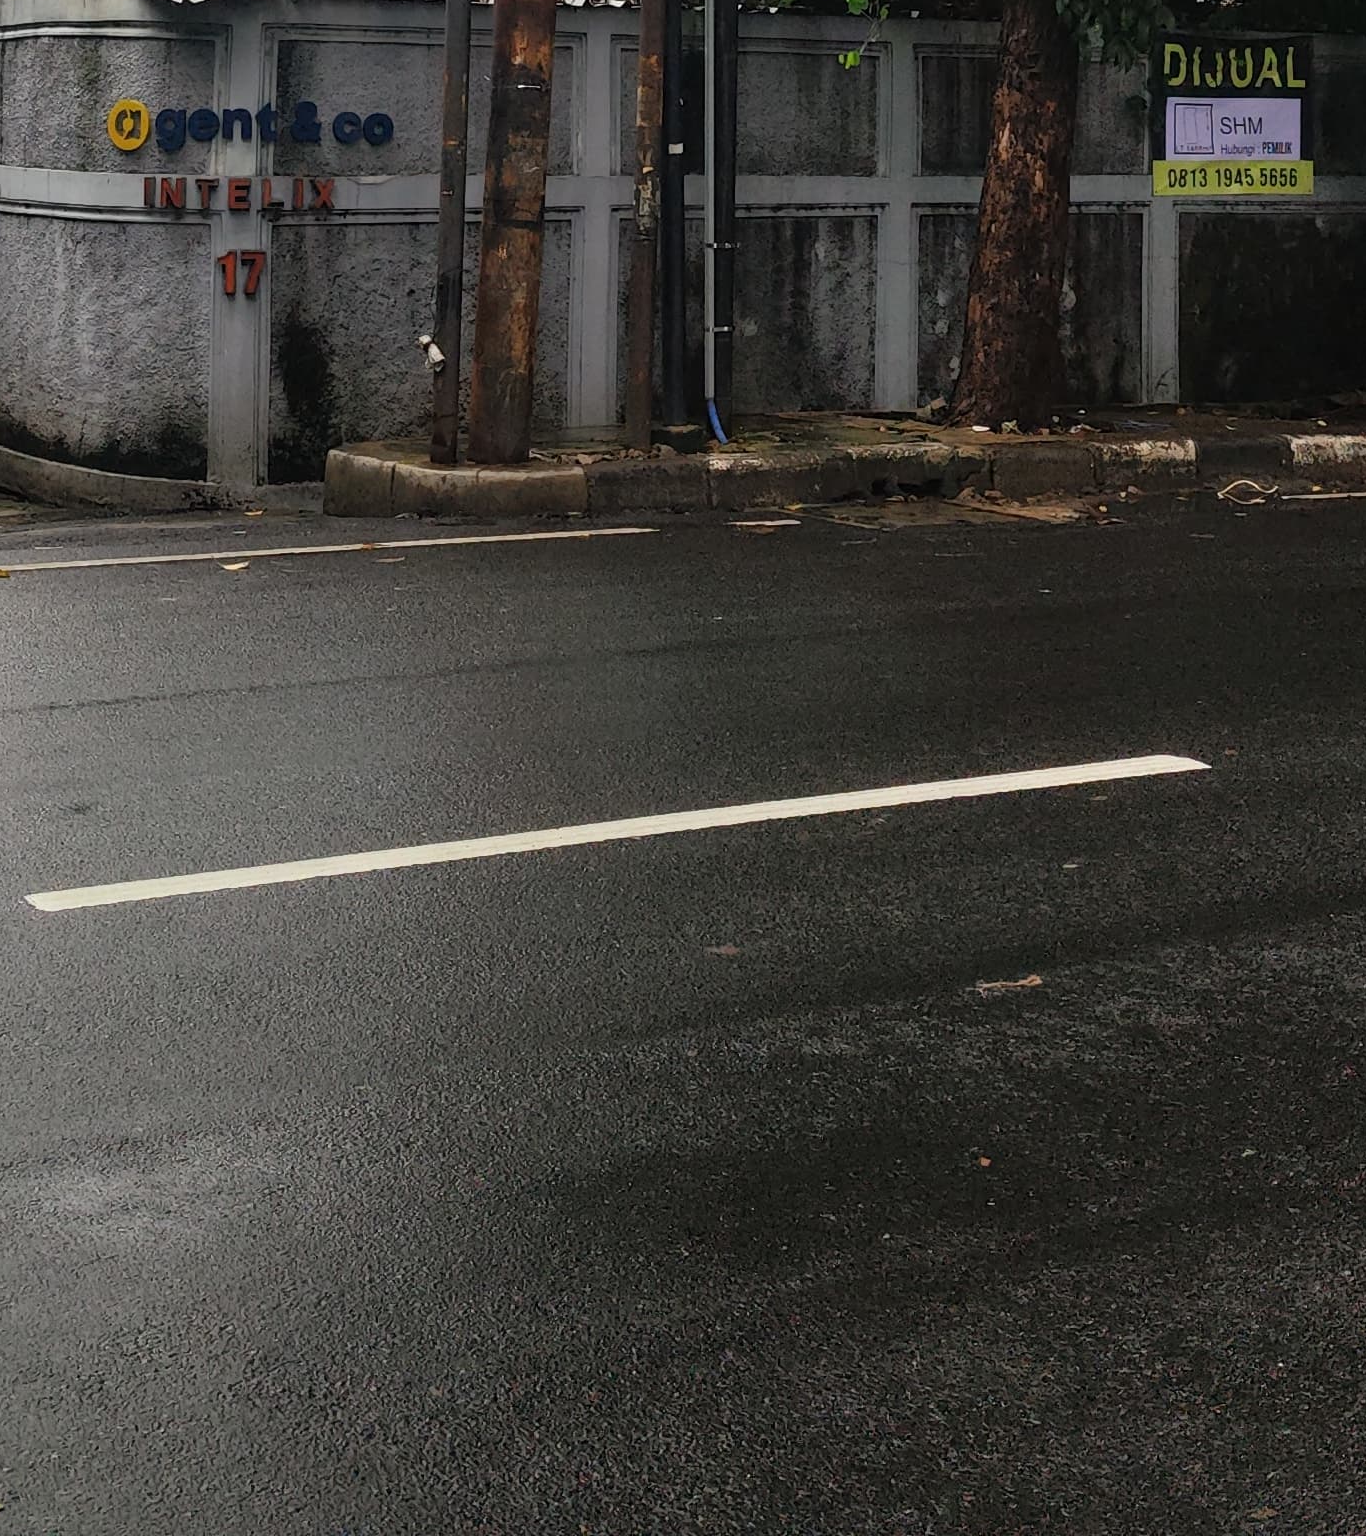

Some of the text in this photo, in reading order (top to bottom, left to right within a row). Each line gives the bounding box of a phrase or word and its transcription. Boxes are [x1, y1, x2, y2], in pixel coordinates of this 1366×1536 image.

[1163, 42, 1306, 89] DIJUAL
[106, 98, 394, 152] agent & co
[1219, 116, 1263, 135] SHM
[1261, 141, 1293, 155] PEMILIK
[143, 175, 337, 211] INTELIX
[1167, 167, 1298, 189] 0813 1945 5656
[217, 249, 266, 296] 17
